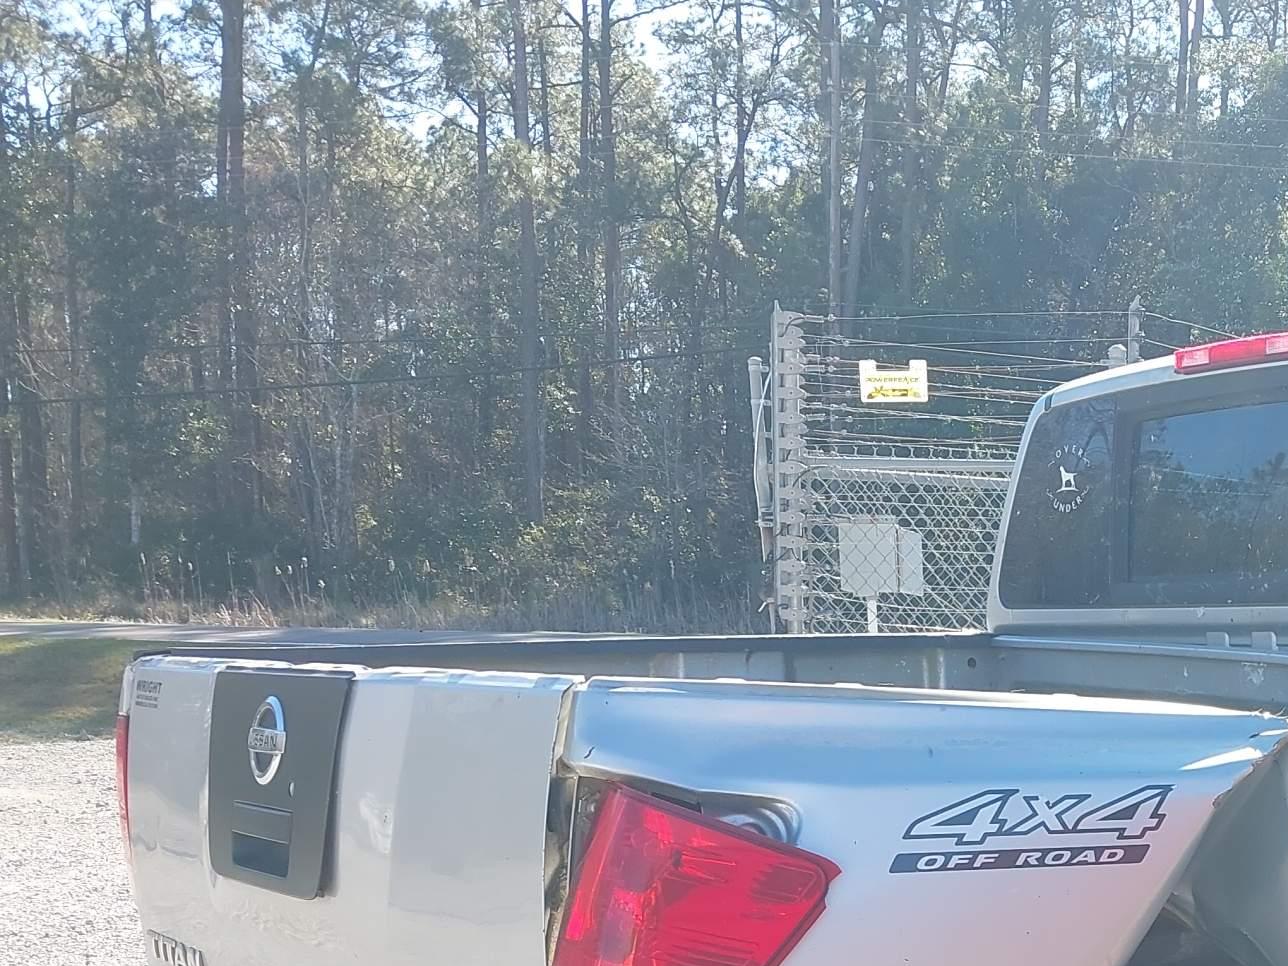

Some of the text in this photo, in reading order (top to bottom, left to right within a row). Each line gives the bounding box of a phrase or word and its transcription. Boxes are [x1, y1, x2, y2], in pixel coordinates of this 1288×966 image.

[1055, 444, 1084, 459] OVER
[1053, 495, 1082, 513] UNDER
[916, 848, 1125, 871] OFF ROAD
